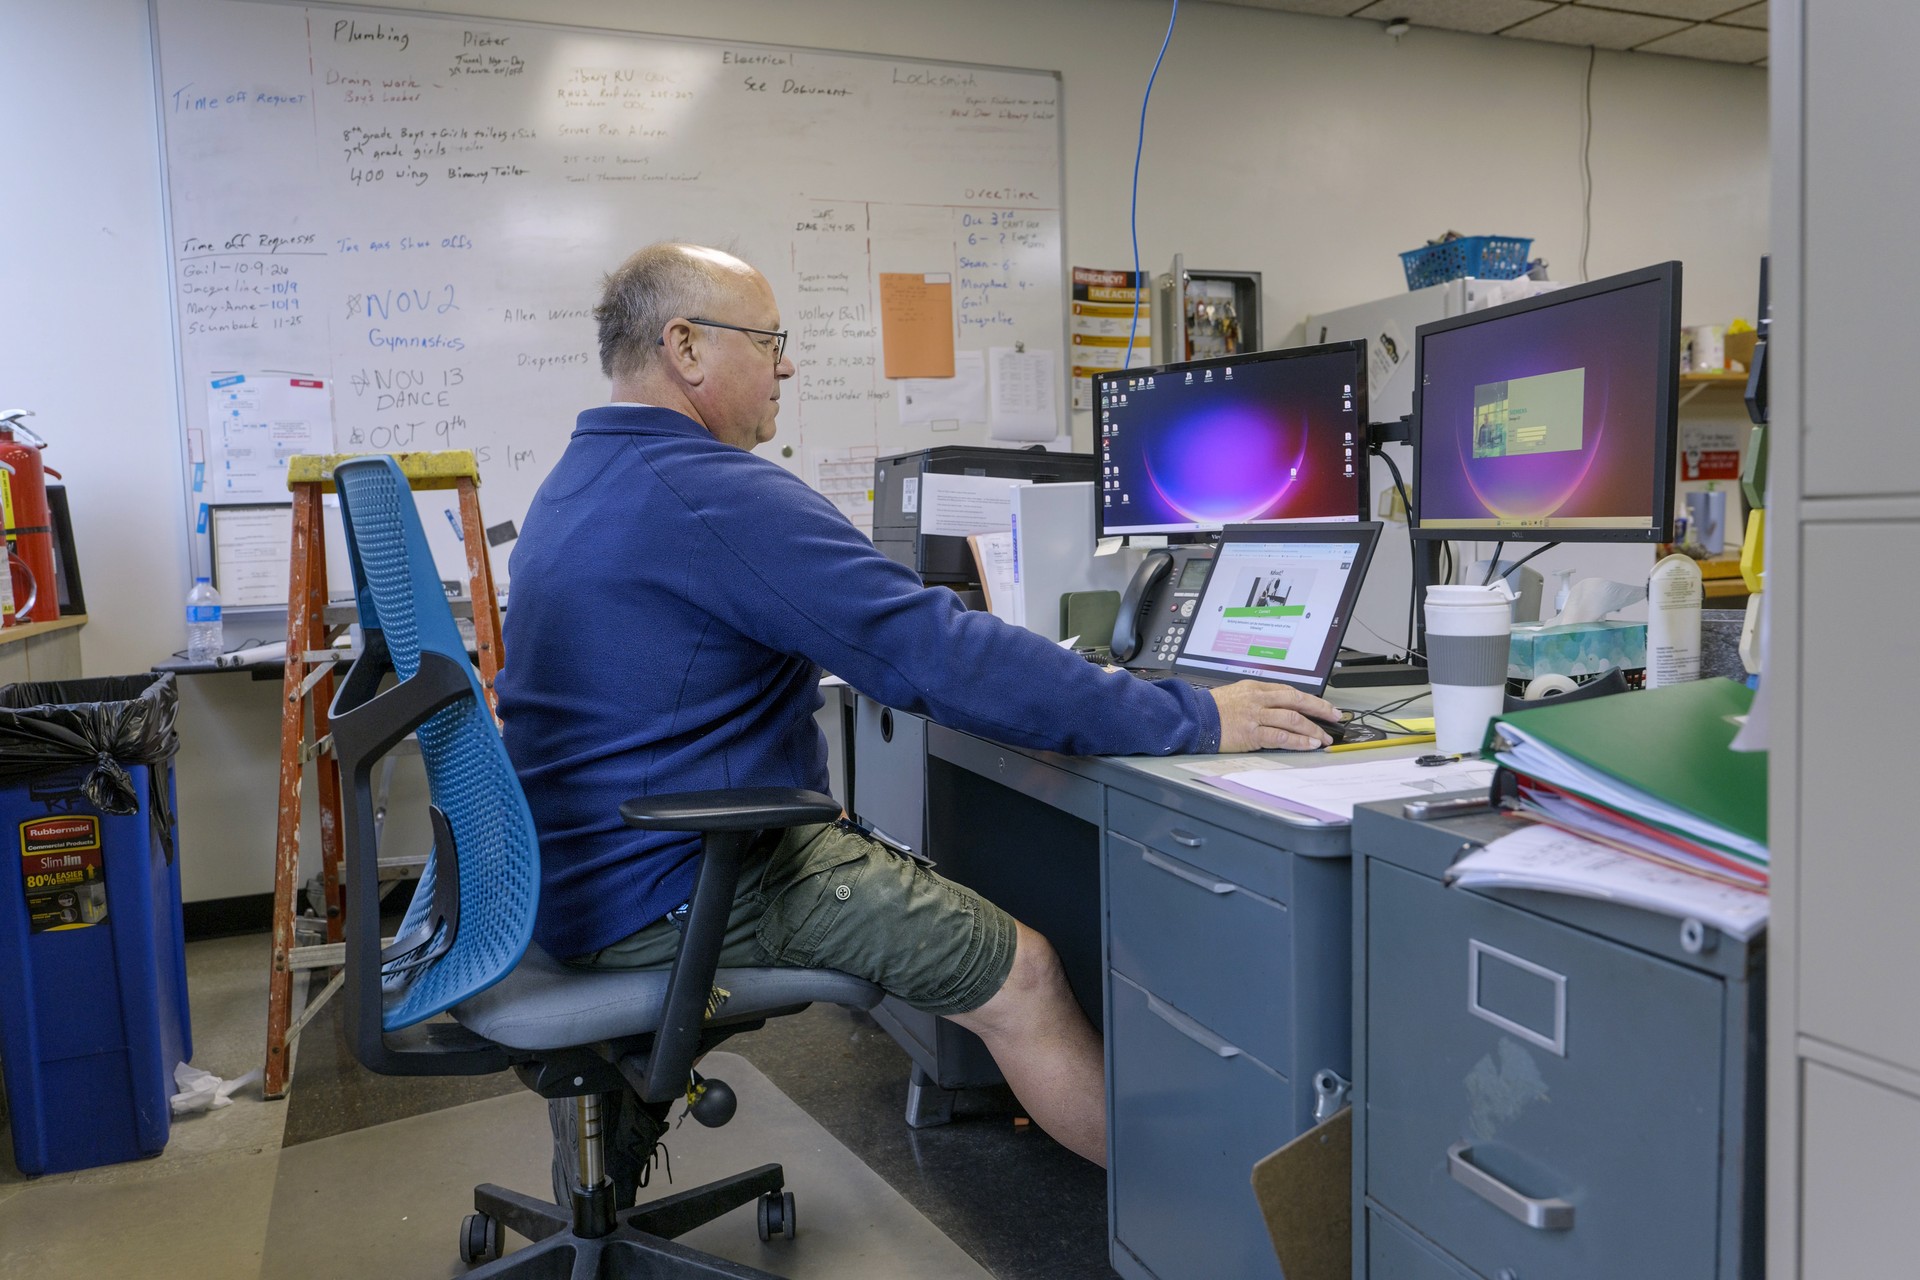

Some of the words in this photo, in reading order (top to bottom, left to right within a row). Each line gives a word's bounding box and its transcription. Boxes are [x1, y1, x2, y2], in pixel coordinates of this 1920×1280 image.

[333, 20, 410, 51] Plumbing
[463, 31, 510, 47] Dieter
[722, 51, 794, 67] Electrical
[326, 67, 371, 87] Drain
[382, 75, 420, 88] work
[744, 76, 767, 92] See
[226, 91, 247, 104] off
[362, 127, 392, 146] grade
[373, 144, 403, 160] grade
[414, 141, 446, 160] girls
[350, 167, 384, 187] 400
[181, 238, 214, 252] Time
[225, 234, 250, 249] off
[259, 234, 316, 254] Requests
[968, 232, 977, 245] 6
[184, 261, 216, 277] Gail
[366, 289, 431, 320] NOV
[437, 283, 460, 314] 2
[961, 294, 989, 309] Gail
[504, 308, 537, 323] Allen
[549, 303, 594, 321] Wrenc
[839, 304, 866, 321] Ball
[369, 328, 465, 352] Gymnastics
[803, 323, 837, 339] Home
[841, 323, 877, 338] Games
[517, 352, 589, 372] Dispensers
[374, 368, 424, 390] NOV
[443, 368, 464, 387] 13
[803, 375, 812, 387] 2
[376, 391, 450, 411] DANCE
[370, 421, 426, 449] OCT
[435, 415, 467, 447] 9th
[30, 825, 89, 836] Rubbermaid
[28, 843, 65, 851] Commercial
[27, 873, 56, 888] 80%
[56, 870, 83, 879] EASIER
